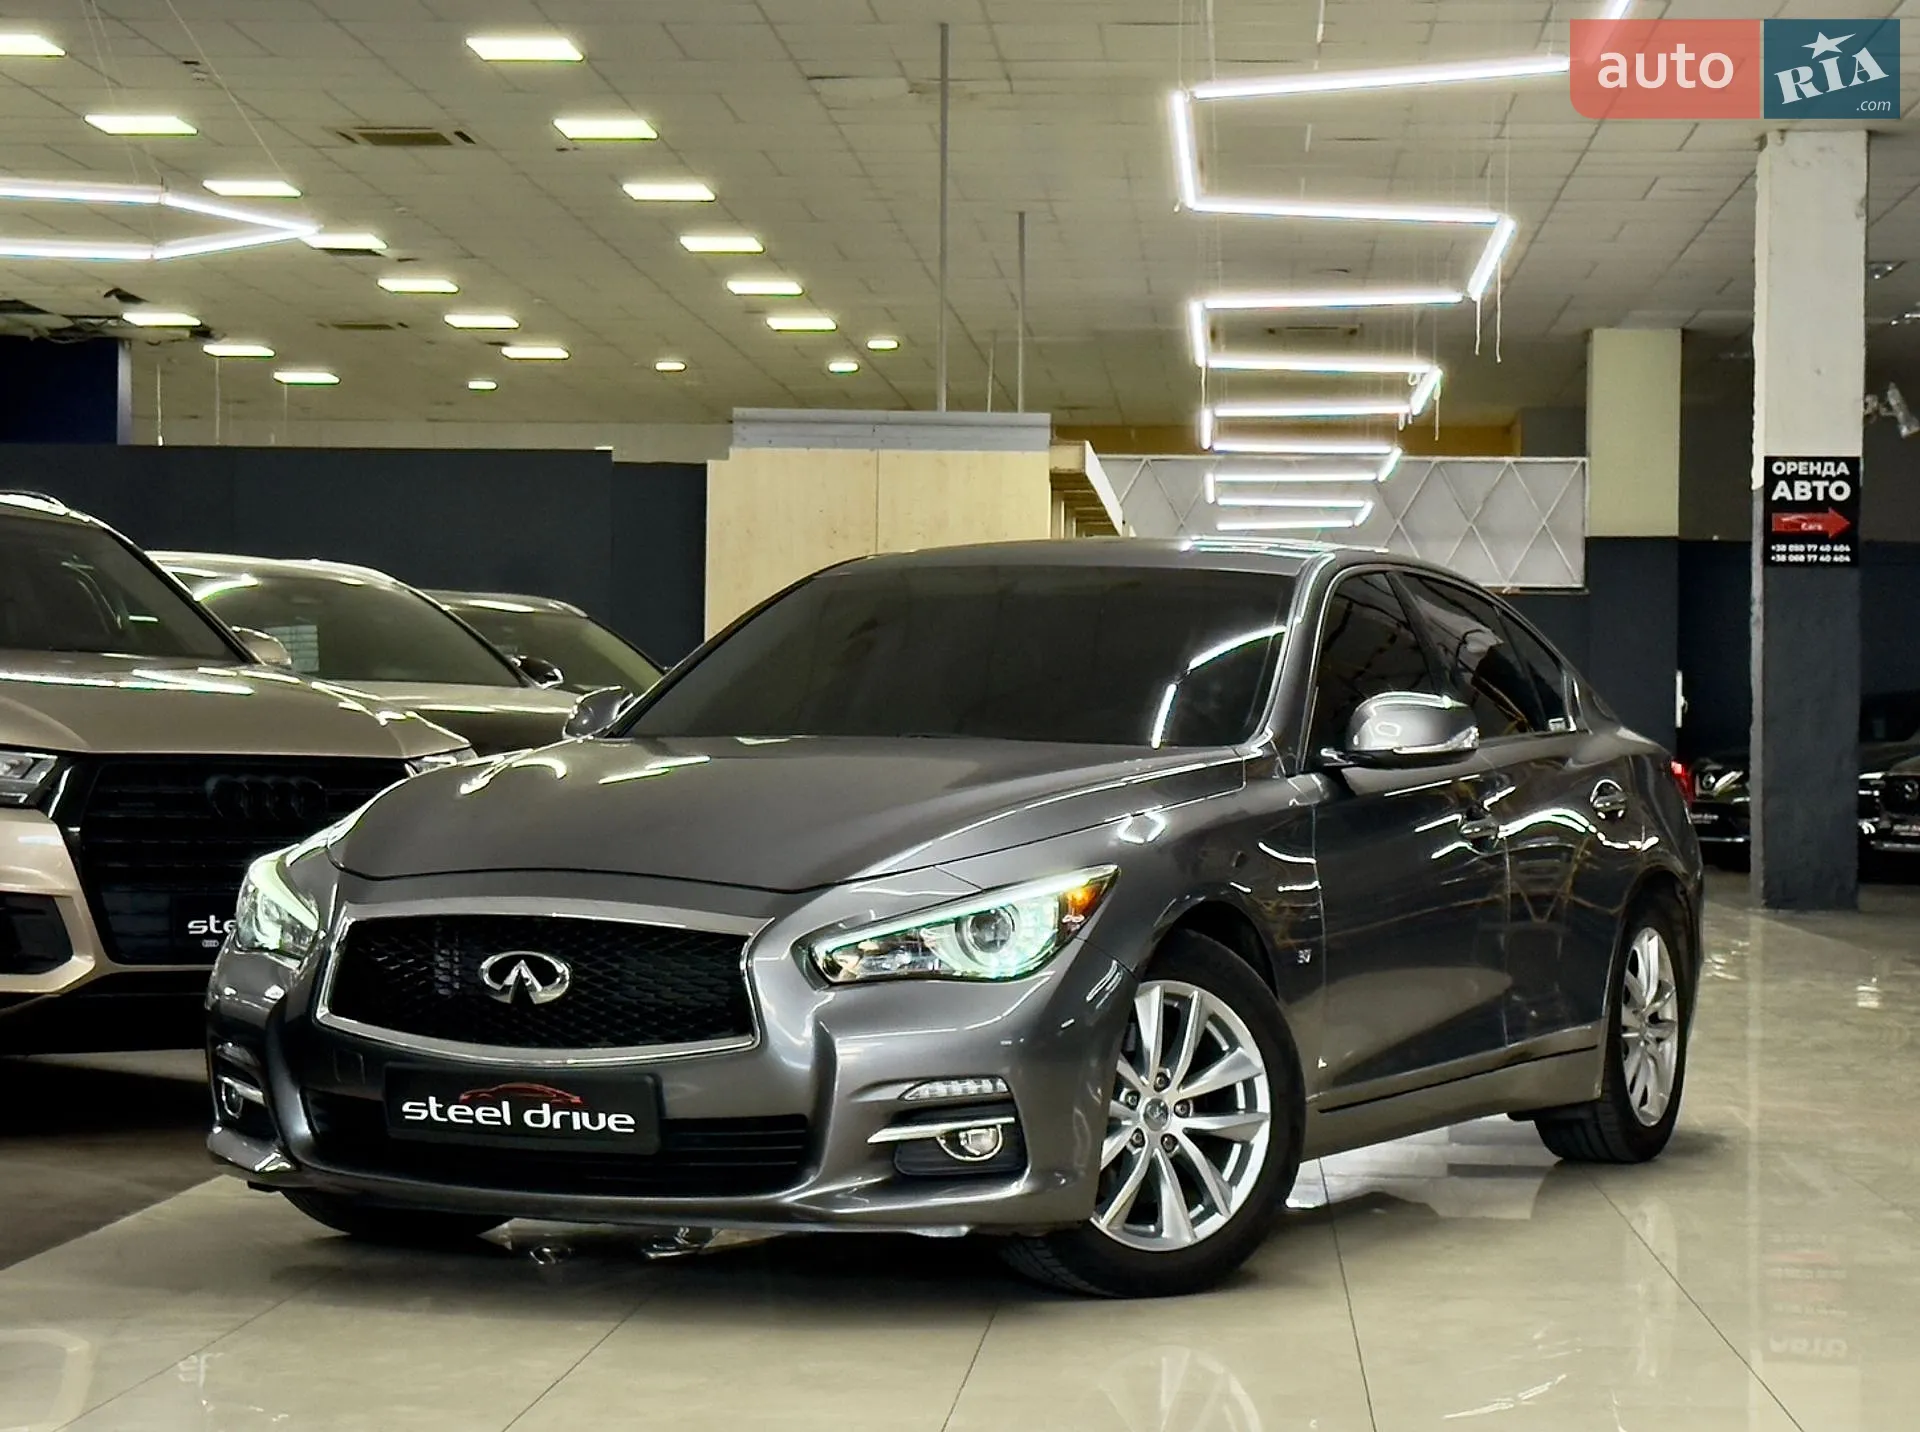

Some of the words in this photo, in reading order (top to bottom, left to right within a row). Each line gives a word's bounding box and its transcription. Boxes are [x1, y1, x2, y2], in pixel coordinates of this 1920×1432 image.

[1771, 461, 1850, 477] ОРЕНДА
[1771, 480, 1851, 501] АВТО
[402, 1096, 512, 1126] steel
[523, 1103, 636, 1133] drive
